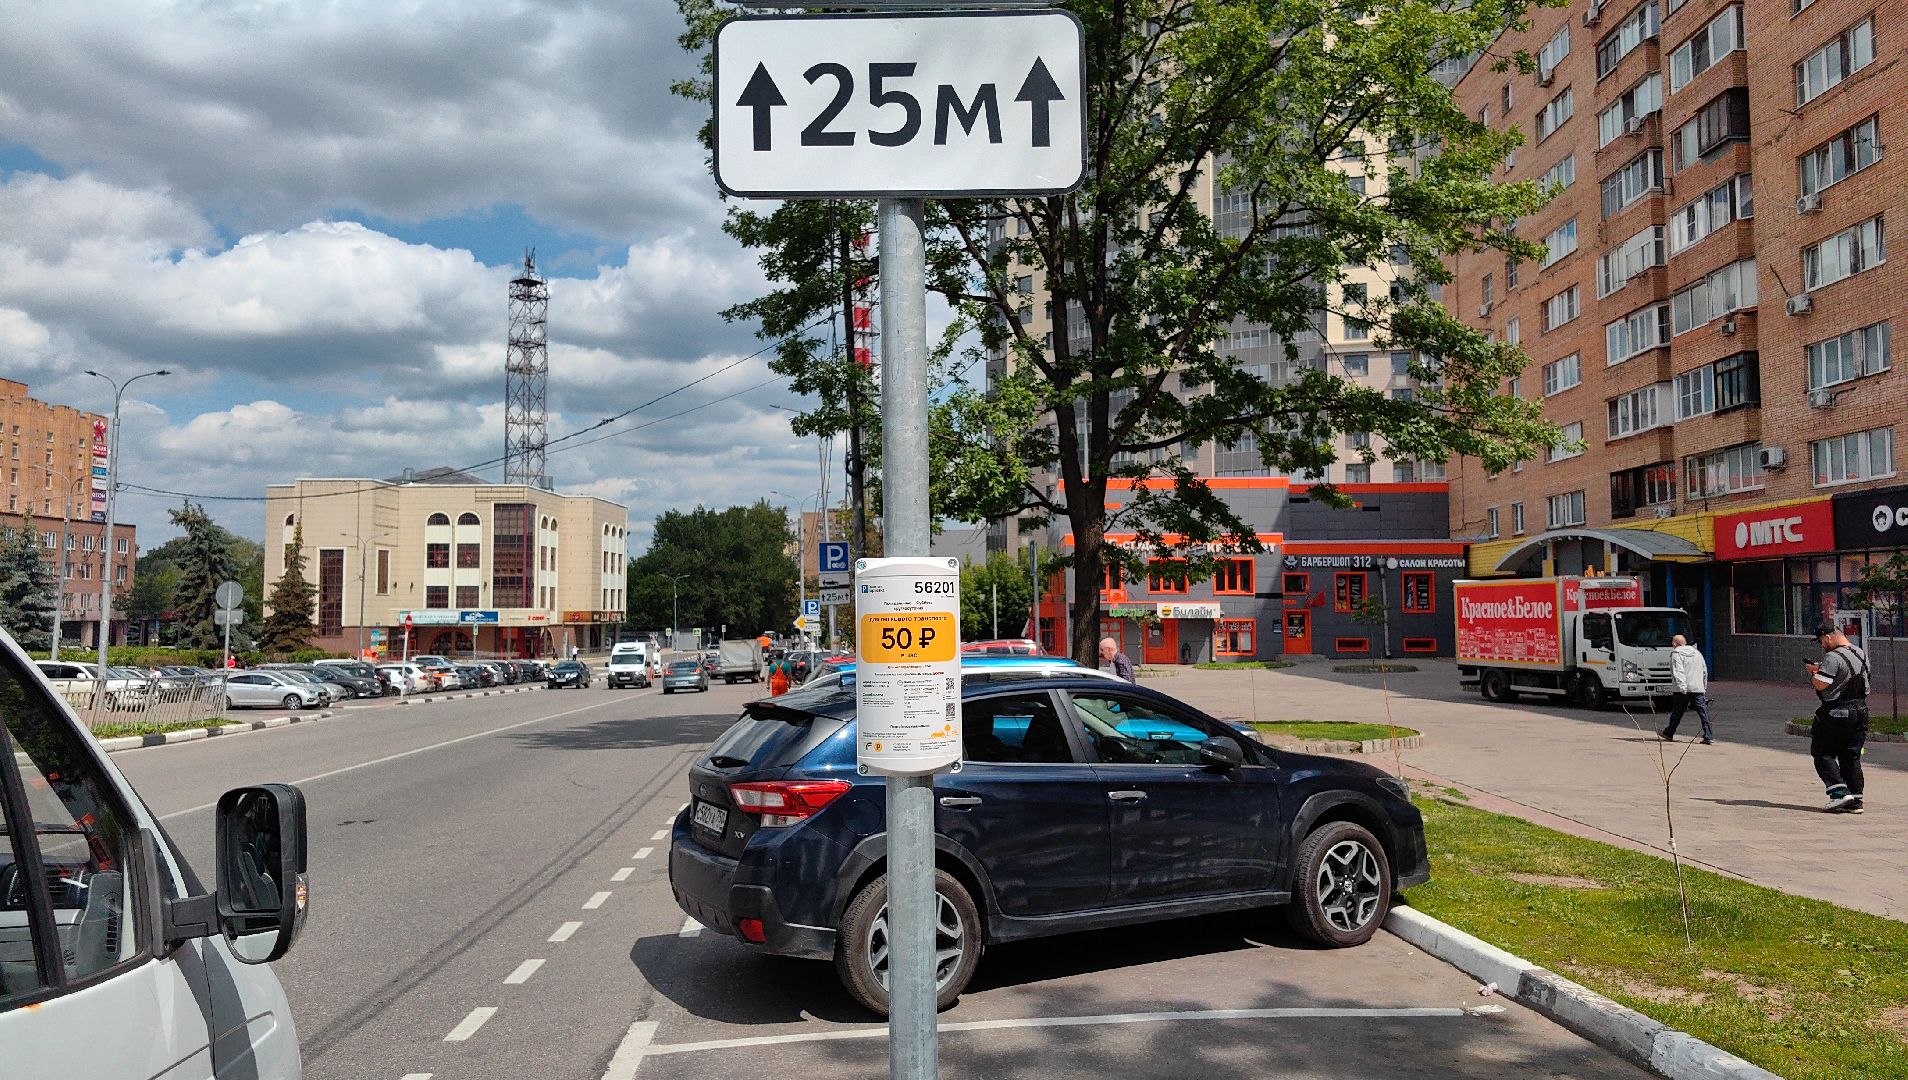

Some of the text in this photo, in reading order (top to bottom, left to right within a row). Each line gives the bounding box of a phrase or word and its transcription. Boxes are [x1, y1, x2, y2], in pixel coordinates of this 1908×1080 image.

[1750, 516, 1804, 547] МТС
[1301, 556, 1372, 568] БАРБЕРШОП 312
[1399, 558, 1466, 568] САЛОН КРАСОТЫ
[915, 581, 954, 594] 56201
[1566, 587, 1637, 605] Крсное&Белое
[1461, 595, 1553, 625] Красное&Белое
[882, 627, 912, 650] 50
[735, 830, 746, 839] XV
